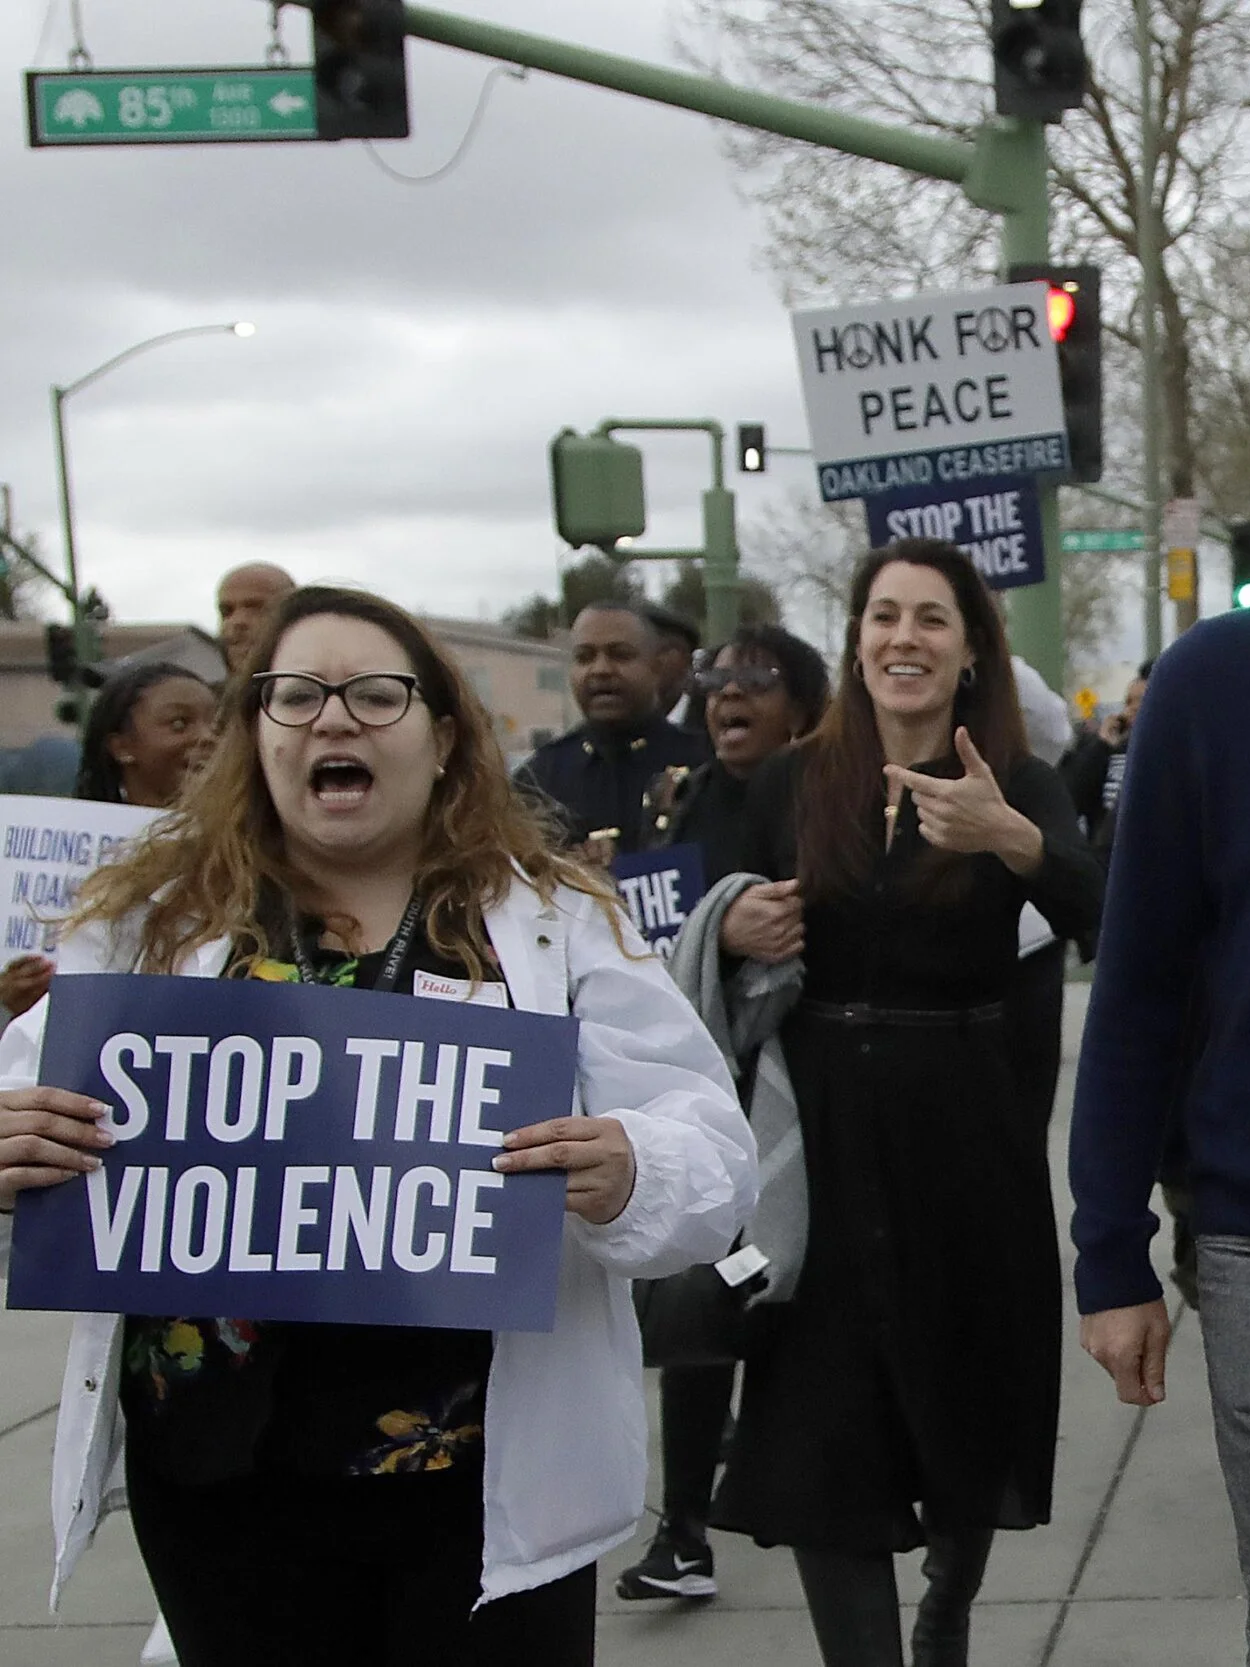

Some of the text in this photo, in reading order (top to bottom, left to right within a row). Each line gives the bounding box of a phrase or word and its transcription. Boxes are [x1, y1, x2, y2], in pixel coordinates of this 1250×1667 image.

[813, 304, 1041, 374] HONK FOR
[859, 374, 1012, 435] PEACE
[820, 438, 1064, 497] OAKLAND CEASEFIRE
[887, 490, 1022, 542] STOP THE
[3, 825, 92, 865] BUILDING
[11, 871, 30, 903] IN
[617, 868, 685, 933] THE
[383, 900, 421, 979] OUTH ALIVE!
[422, 980, 458, 995] Hello
[100, 1032, 512, 1147] STOP THE
[86, 1164, 504, 1274] VIOLENCE
